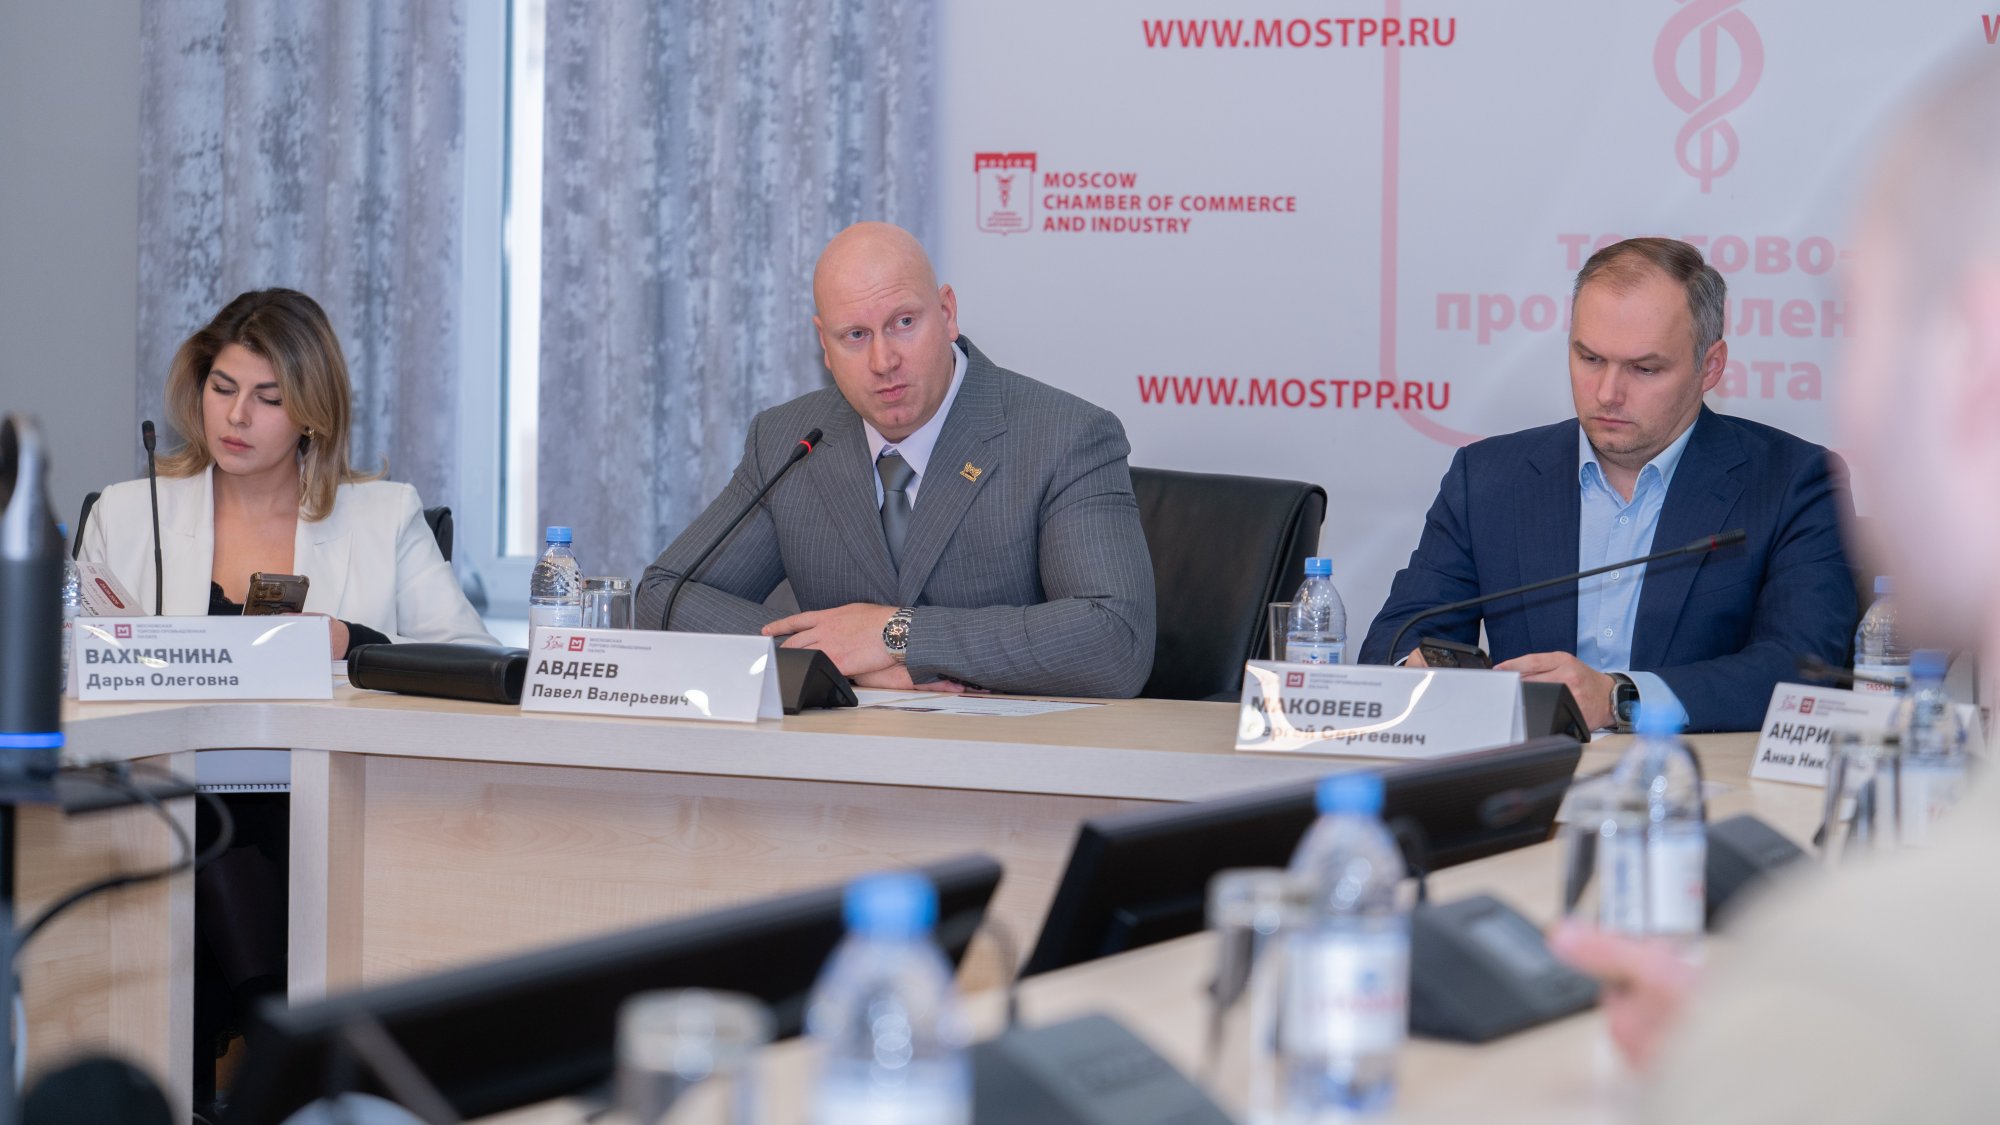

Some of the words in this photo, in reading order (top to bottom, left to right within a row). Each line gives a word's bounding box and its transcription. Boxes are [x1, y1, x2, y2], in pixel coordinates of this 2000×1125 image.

[1142, 17, 1456, 48] WWW.MOSTPP.RU
[1043, 173, 1138, 188] MOSCOW
[1043, 194, 1142, 212] CHAMBER
[1147, 195, 1175, 212] OF
[1180, 195, 1297, 213] COMMERCE
[1043, 217, 1086, 233] AND
[1091, 218, 1192, 234] INDUSTRY
[1557, 233, 1857, 276] тово-
[1138, 375, 1450, 411] WWW.MOSTPP.RU
[85, 648, 233, 664] ВАХМЯНИНА
[535, 659, 619, 680] АВДЕЕВ
[86, 673, 145, 690] Дарья
[150, 672, 240, 686] Олеговна
[531, 683, 583, 701] Павел
[586, 686, 690, 707] Валерьевич
[1251, 697, 1383, 718] МАКОВЕЕВ
[1321, 724, 1427, 745] Сергеевич
[1768, 720, 1833, 745] АНДРИ
[1761, 748, 1796, 766] Анна
